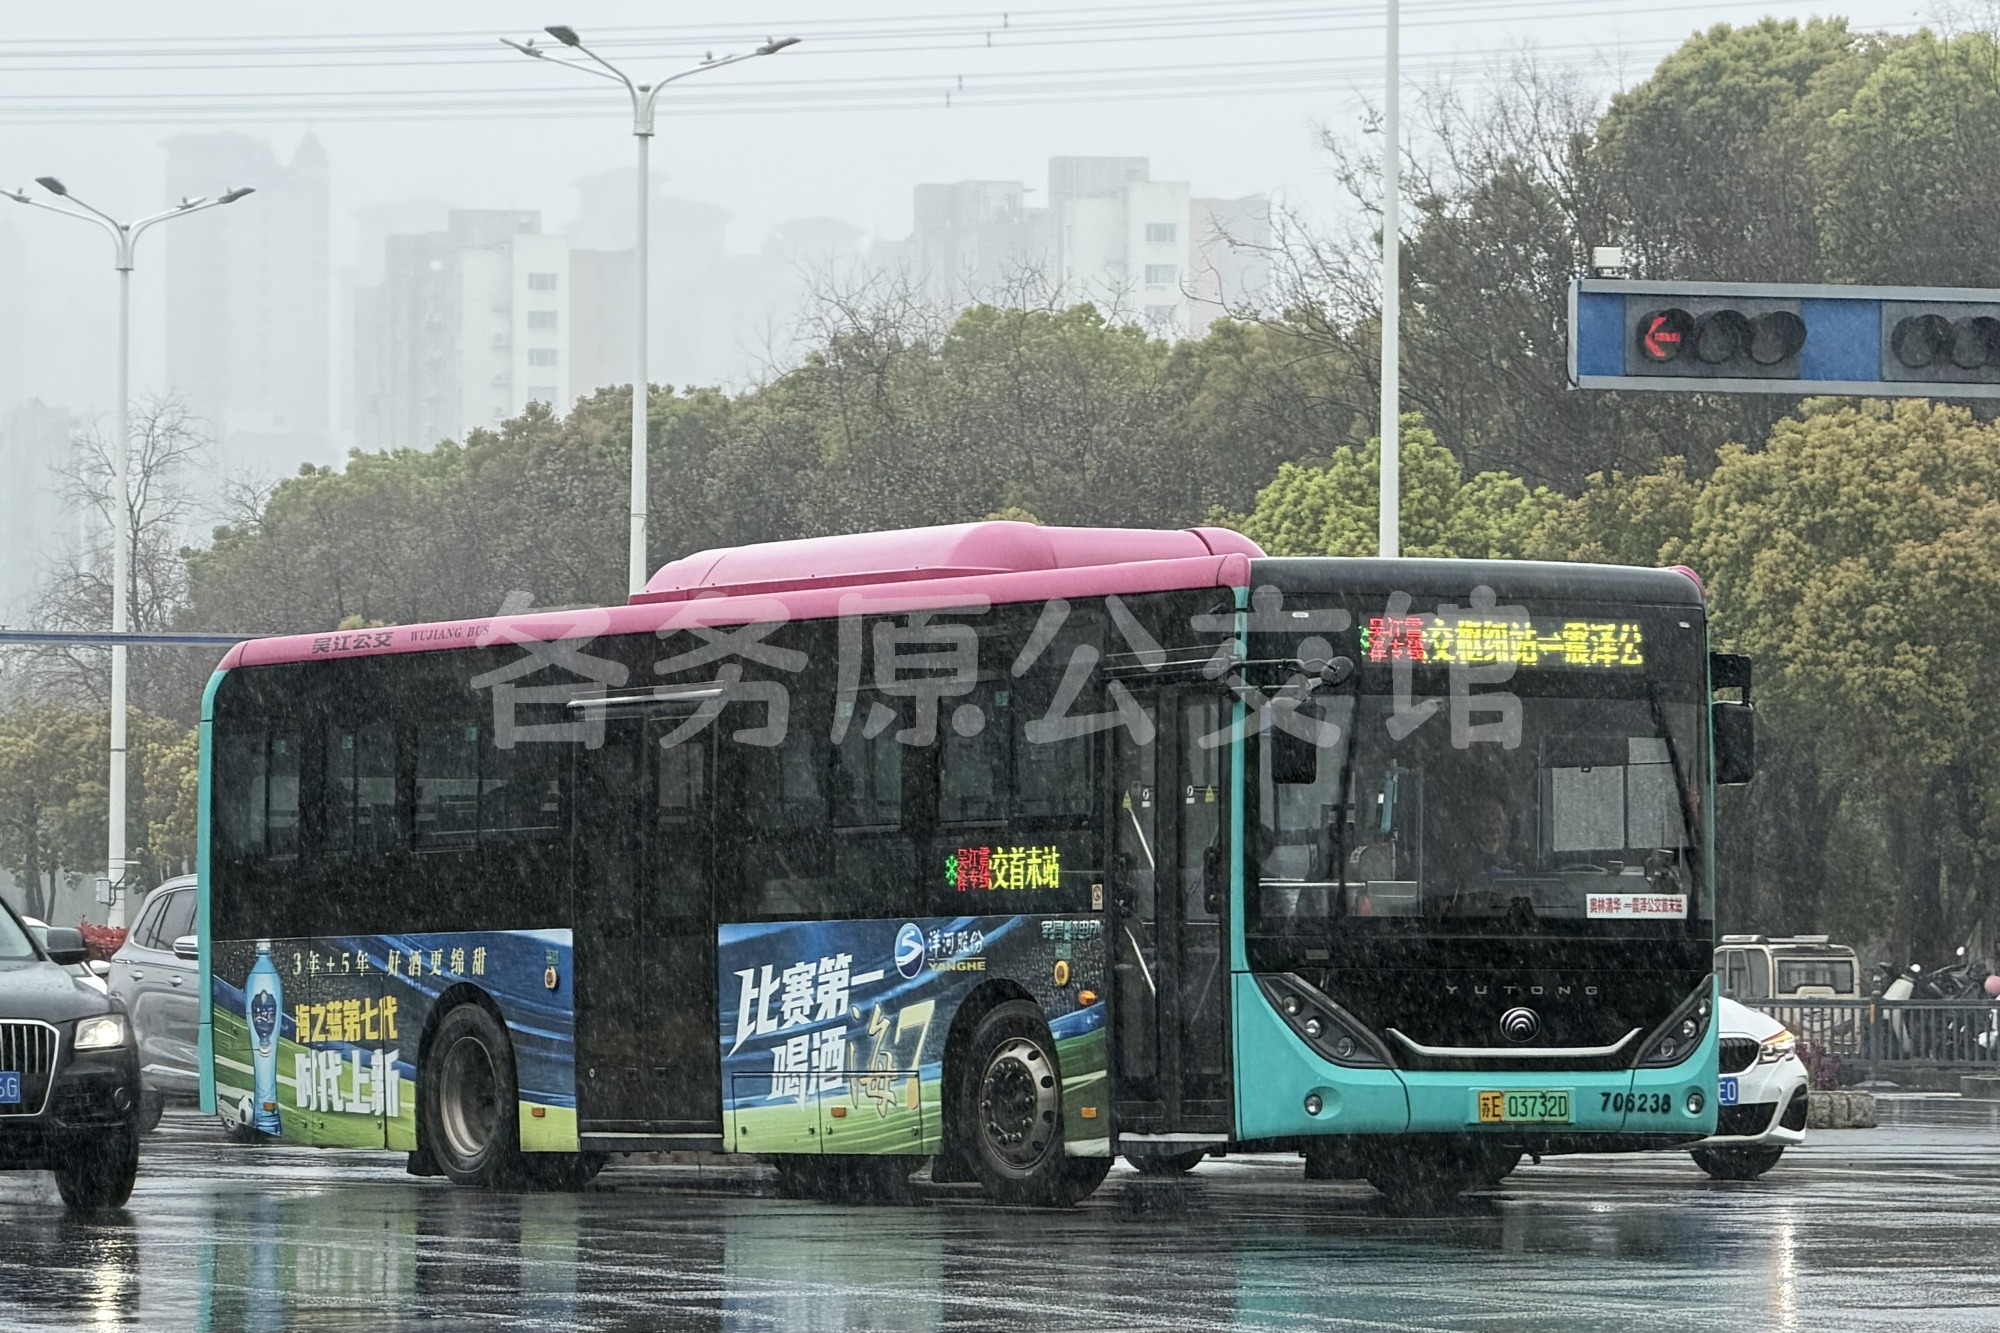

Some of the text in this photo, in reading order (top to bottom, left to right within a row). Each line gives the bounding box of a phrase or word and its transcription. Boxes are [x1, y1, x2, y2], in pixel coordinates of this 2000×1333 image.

[312, 632, 394, 653] 吴江公交
[410, 624, 490, 643] WUJIANG BUS
[989, 845, 1061, 890] 交首末站
[927, 930, 984, 954] 洋河股份
[293, 946, 487, 977] 3年+5年 好酒更绵甜
[928, 961, 986, 972] YANGHE
[1445, 985, 1598, 995] YUTONG
[727, 953, 885, 1057] 比赛第一
[295, 995, 398, 1043] 海之蓝第七代
[766, 1025, 846, 1112] 喝酒
[295, 1049, 399, 1117] 时代上新
[1600, 1092, 1672, 1114] 706238
